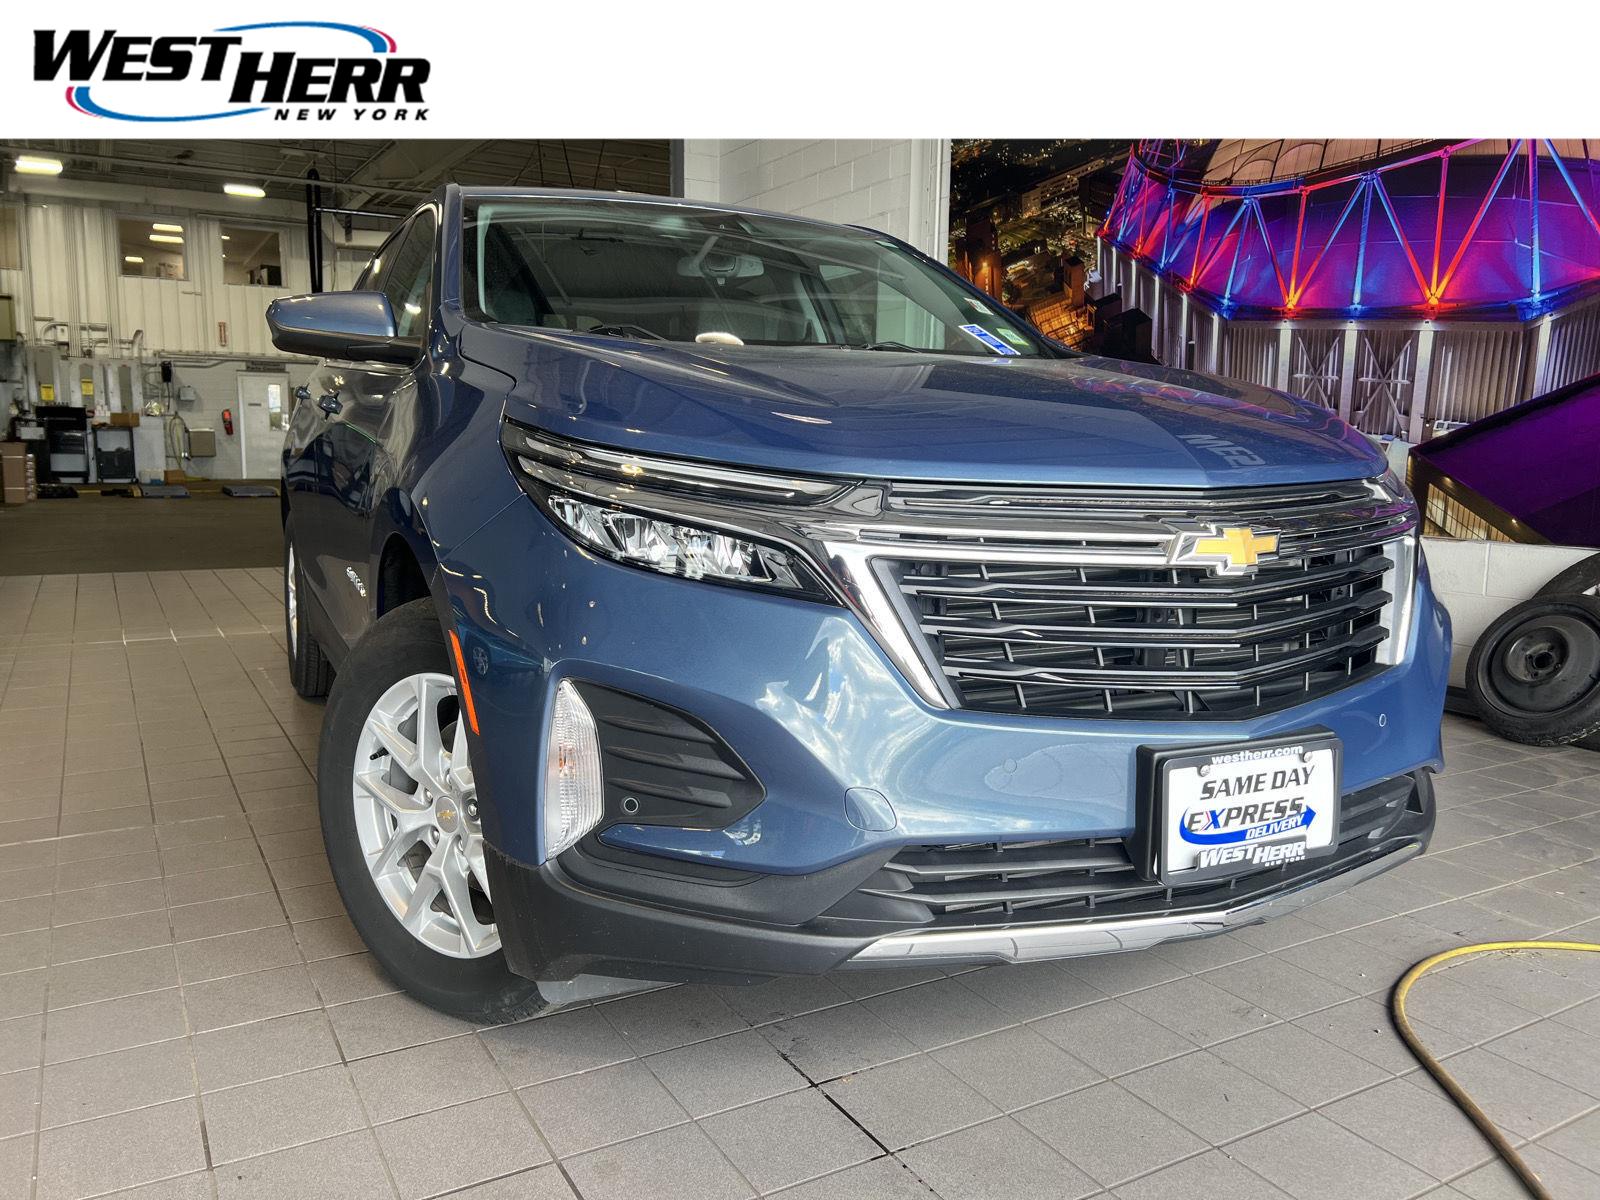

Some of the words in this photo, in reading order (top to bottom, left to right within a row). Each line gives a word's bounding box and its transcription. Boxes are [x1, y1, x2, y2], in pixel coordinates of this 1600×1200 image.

[1211, 745, 1304, 765] westherr.com
[1200, 772, 1267, 801] SAME
[1271, 765, 1316, 790] DAY
[1187, 796, 1305, 833] EXPRESS
[1245, 813, 1305, 841] DELIVERY
[1200, 843, 1259, 869] WEST
[1252, 841, 1306, 865] HERR
